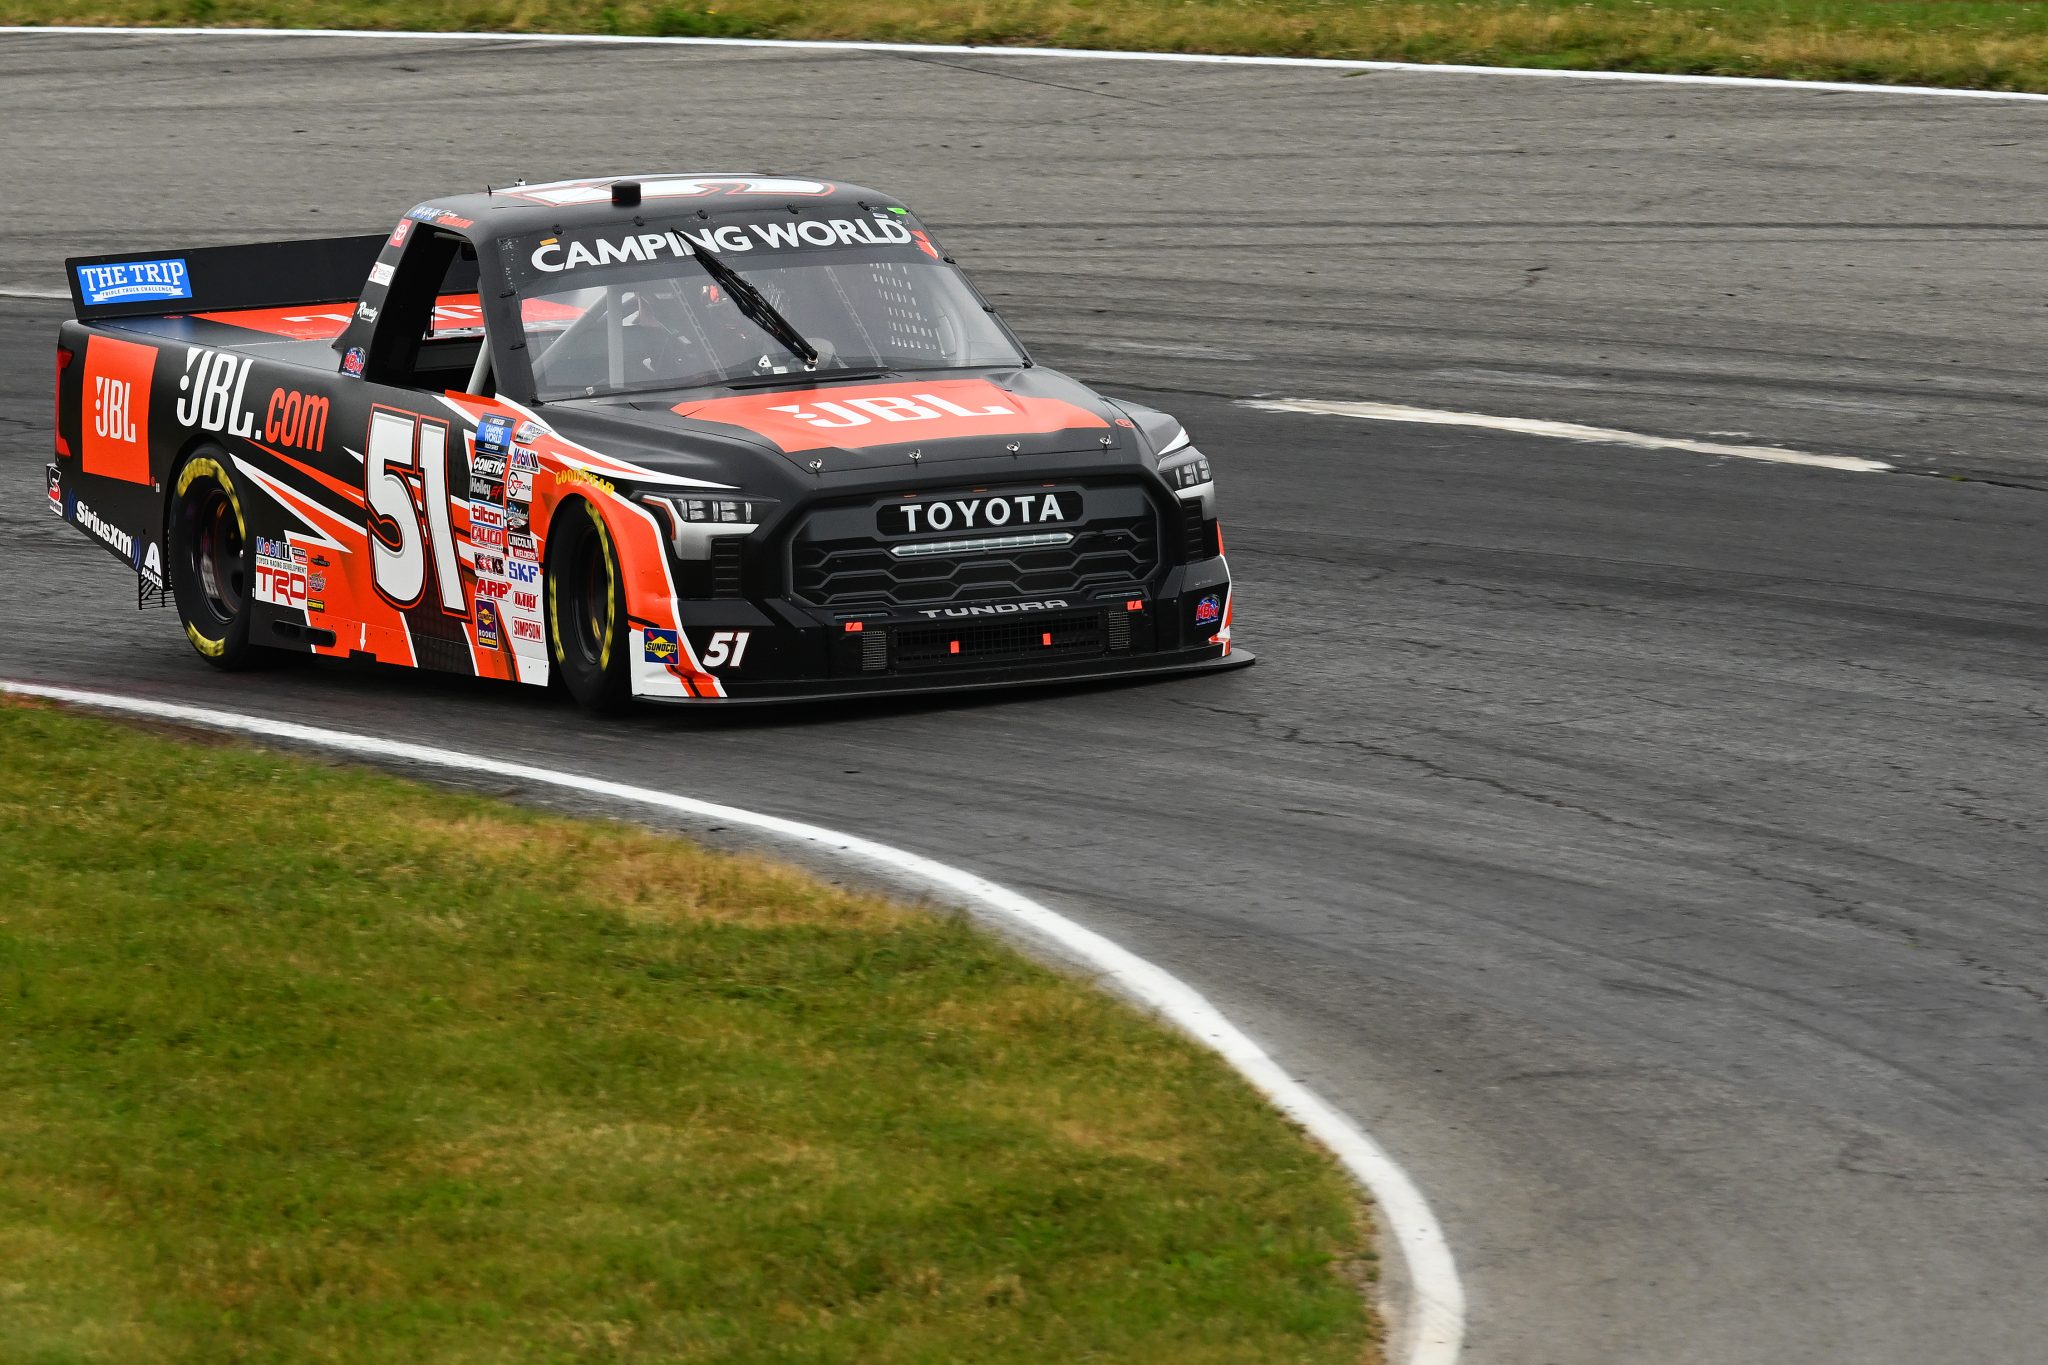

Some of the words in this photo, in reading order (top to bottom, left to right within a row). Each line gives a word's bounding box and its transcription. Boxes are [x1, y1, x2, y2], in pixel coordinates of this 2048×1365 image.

[531, 226, 753, 273] CAMPING
[751, 217, 912, 249] WORLD
[81, 266, 128, 292] THE
[129, 262, 184, 286] TRIP
[140, 285, 173, 293] CHALLENGE
[94, 376, 137, 443] JBL
[767, 393, 1015, 428] JBL
[474, 456, 506, 475] COMETIC
[470, 477, 491, 501] Holley
[556, 466, 616, 496] GOODYEAR
[366, 408, 468, 616] 51
[472, 504, 502, 526] tilton
[900, 494, 1065, 532] TOYOTA
[256, 535, 281, 559] Mobil
[472, 526, 502, 545] CALICO
[509, 535, 533, 549] LINCOLN
[515, 548, 536, 560] WELDERS
[141, 566, 164, 589] AXALTA
[508, 561, 539, 583] SKF
[256, 565, 306, 606] TRD
[477, 578, 509, 599] ARP
[918, 600, 1069, 618] TUNDRA
[513, 619, 541, 640] SIMPSON
[645, 642, 678, 653] SUNOCO
[702, 631, 751, 667] 51
